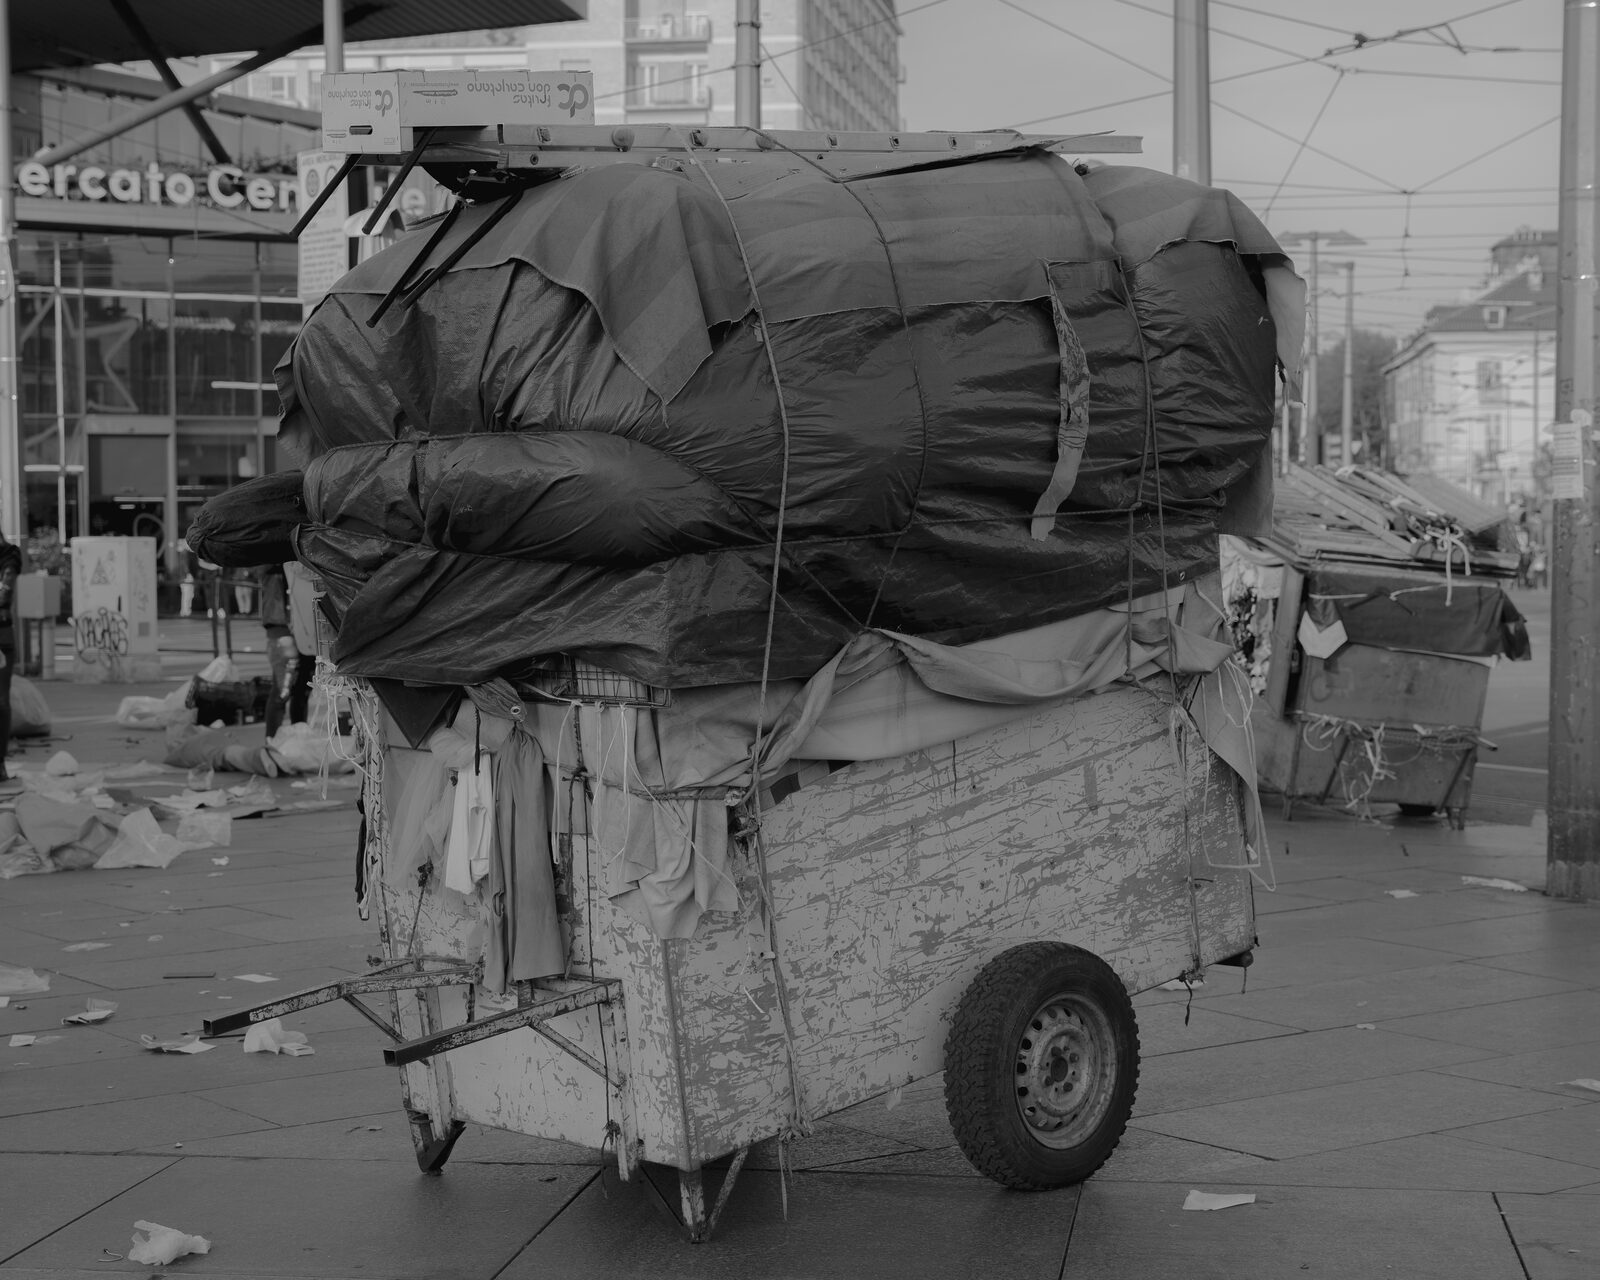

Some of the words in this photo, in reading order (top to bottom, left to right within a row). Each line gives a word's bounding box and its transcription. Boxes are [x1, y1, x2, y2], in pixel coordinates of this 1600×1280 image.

[466, 79, 525, 96] cayetano
[528, 82, 551, 95] don
[512, 94, 551, 108] frutas
[18, 162, 195, 205] ercato
